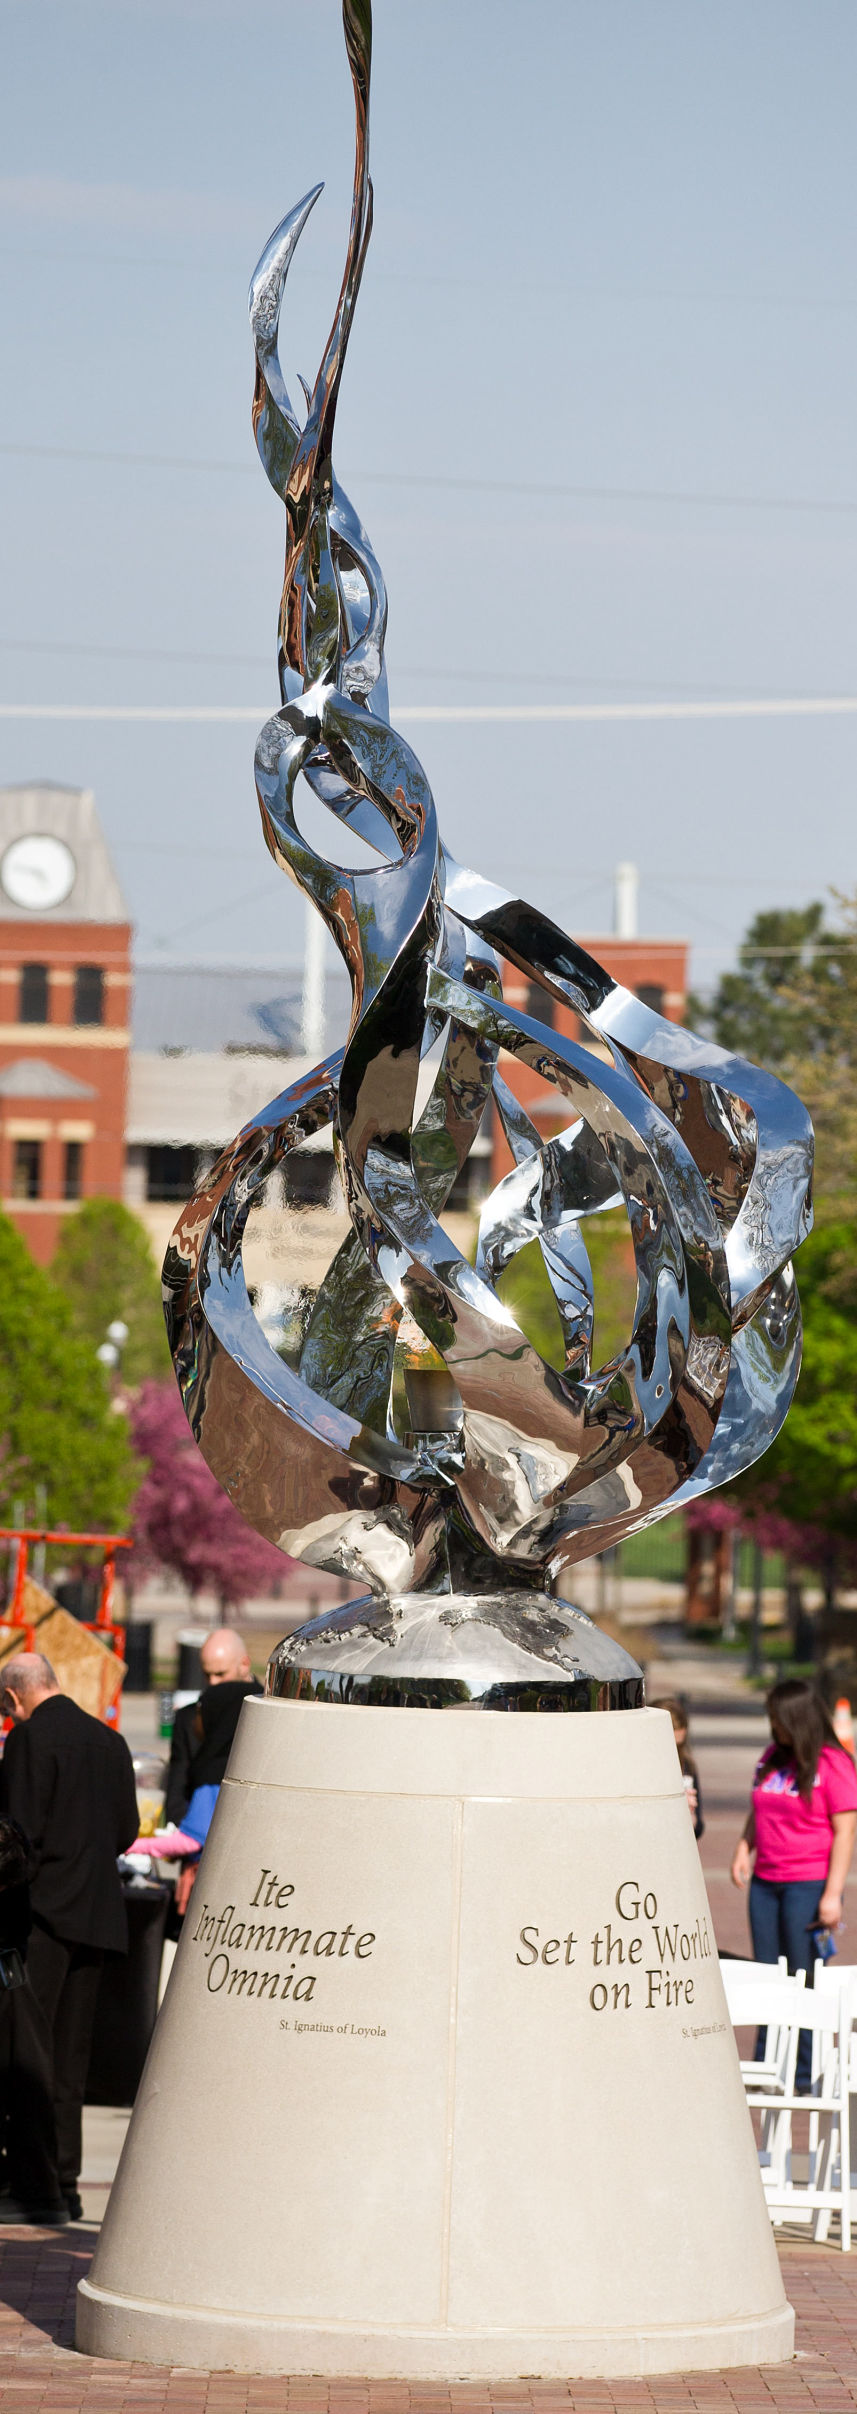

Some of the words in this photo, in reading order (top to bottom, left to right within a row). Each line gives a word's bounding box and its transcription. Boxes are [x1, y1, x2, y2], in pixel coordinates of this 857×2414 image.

[249, 1868, 295, 1909] Ite
[615, 1881, 658, 1921] Go
[192, 1904, 376, 1959] Inflammate
[516, 1926, 578, 1966] Set
[591, 1923, 643, 1967] the
[651, 1917, 711, 1963] World
[207, 1953, 317, 2002] Omnia
[589, 1982, 632, 2011] on
[645, 1969, 695, 2009] Fire
[279, 2019, 290, 2031] St.
[294, 2020, 334, 2034] Ignatius
[336, 2023, 349, 2034] of
[350, 2024, 387, 2038] Loyola
